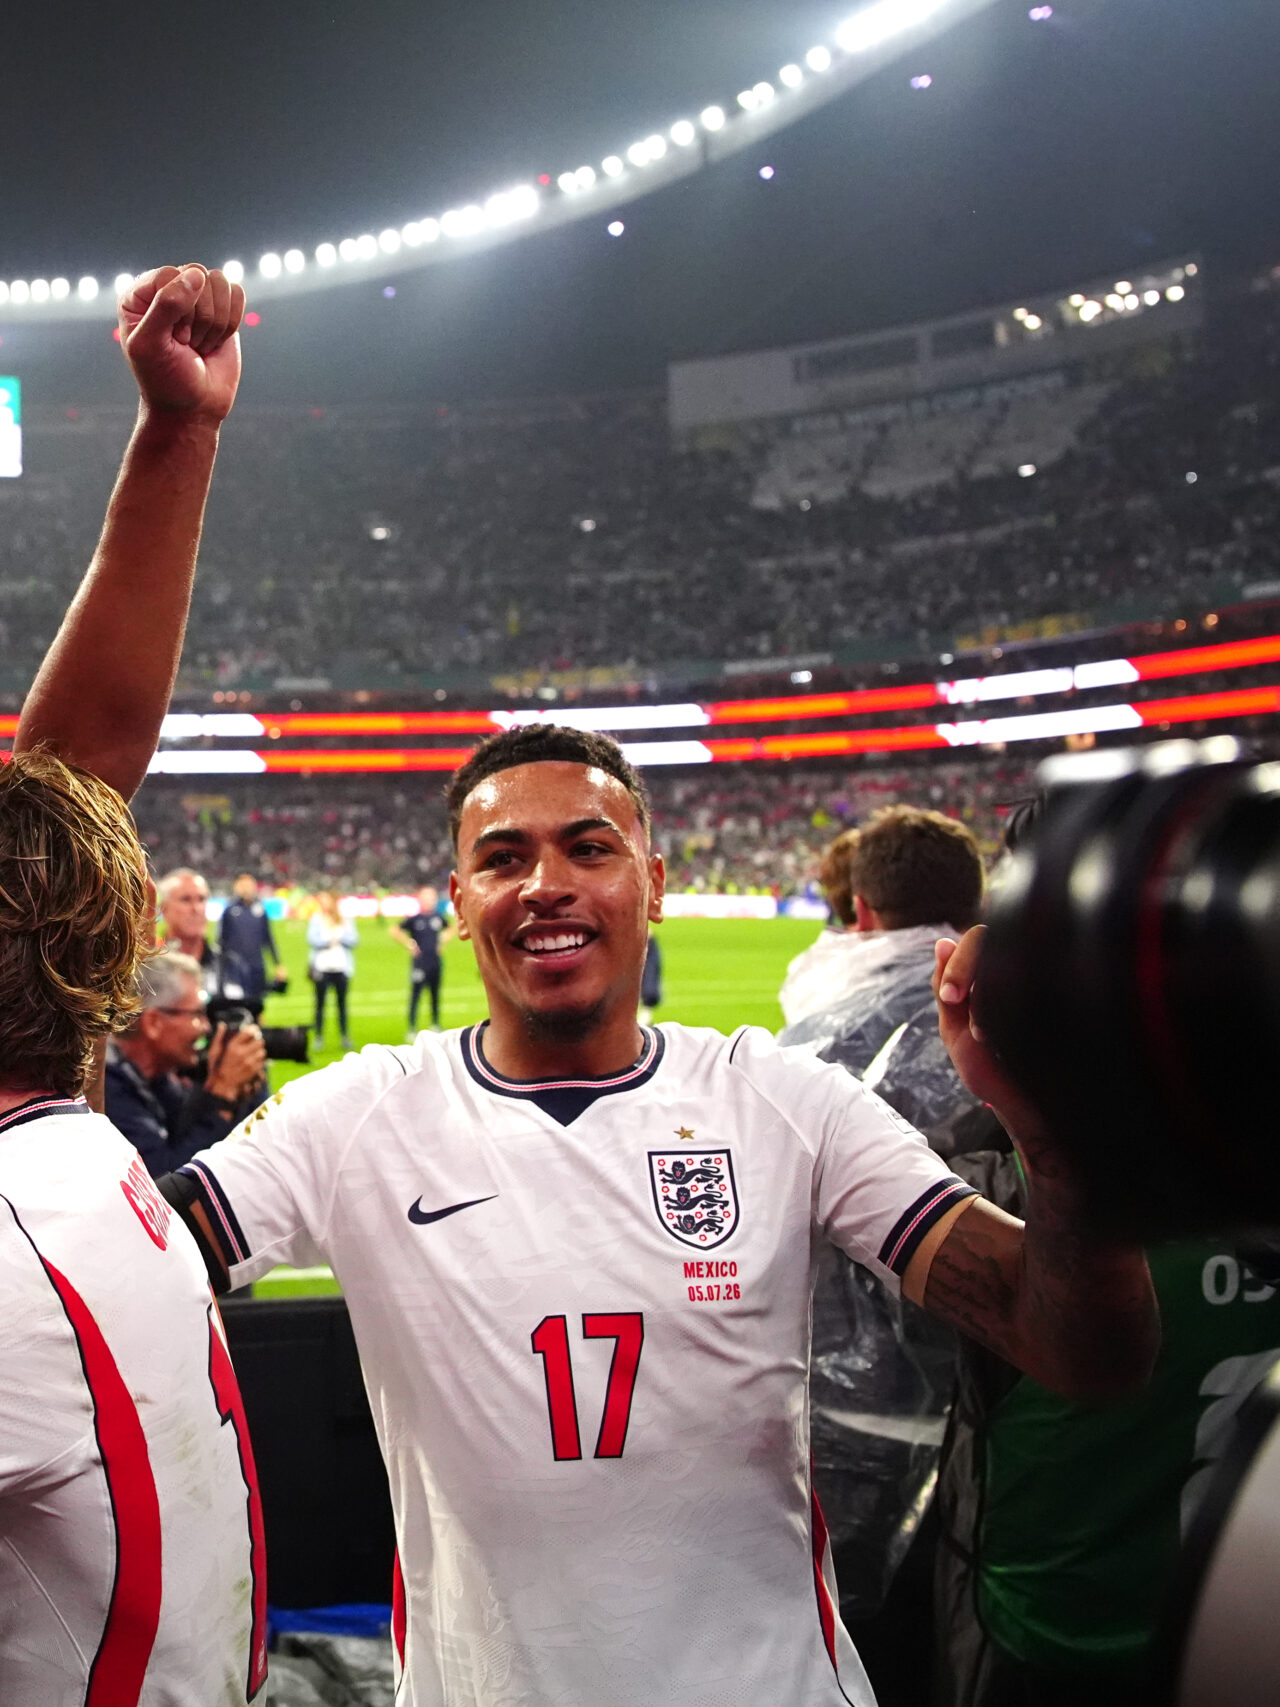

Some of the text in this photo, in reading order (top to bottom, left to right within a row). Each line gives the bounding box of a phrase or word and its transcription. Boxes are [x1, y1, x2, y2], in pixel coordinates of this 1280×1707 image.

[683, 1261, 738, 1278] MEXICO
[687, 1283, 741, 1302] 05.07.26
[531, 1312, 644, 1461] 17
